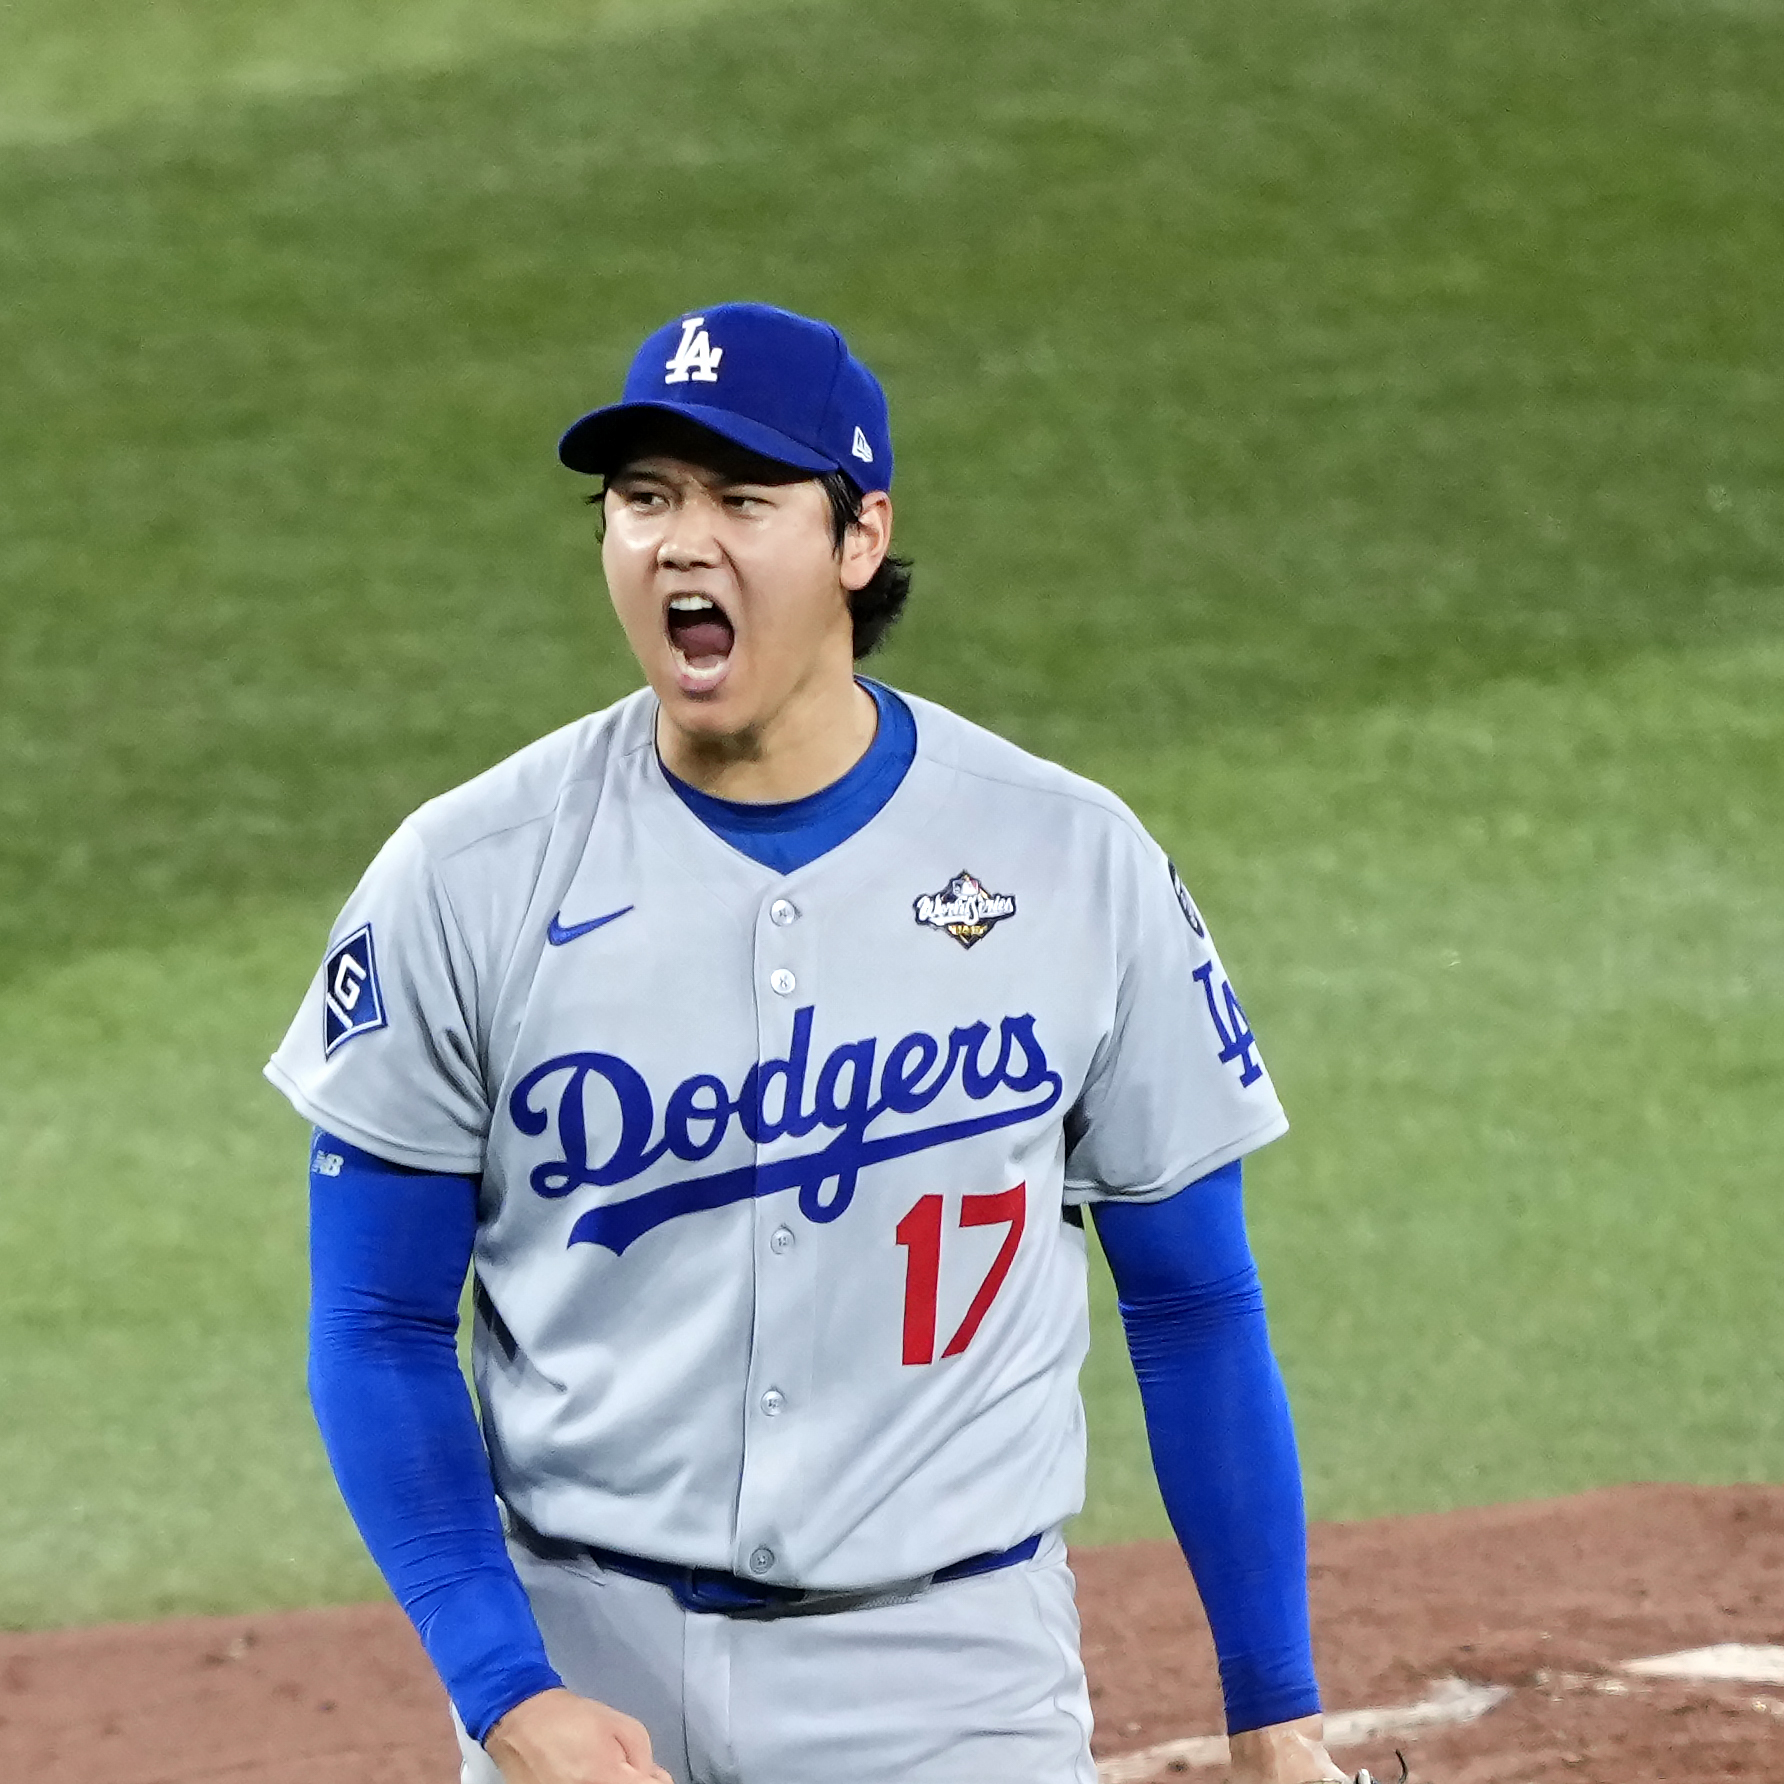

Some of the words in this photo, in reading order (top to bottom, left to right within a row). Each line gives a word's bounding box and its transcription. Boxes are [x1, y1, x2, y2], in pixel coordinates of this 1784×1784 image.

[665, 318, 723, 384] LA
[1192, 960, 1263, 1088] LA
[510, 1005, 1063, 1226] Dodgers
[897, 1181, 1026, 1366] 17
